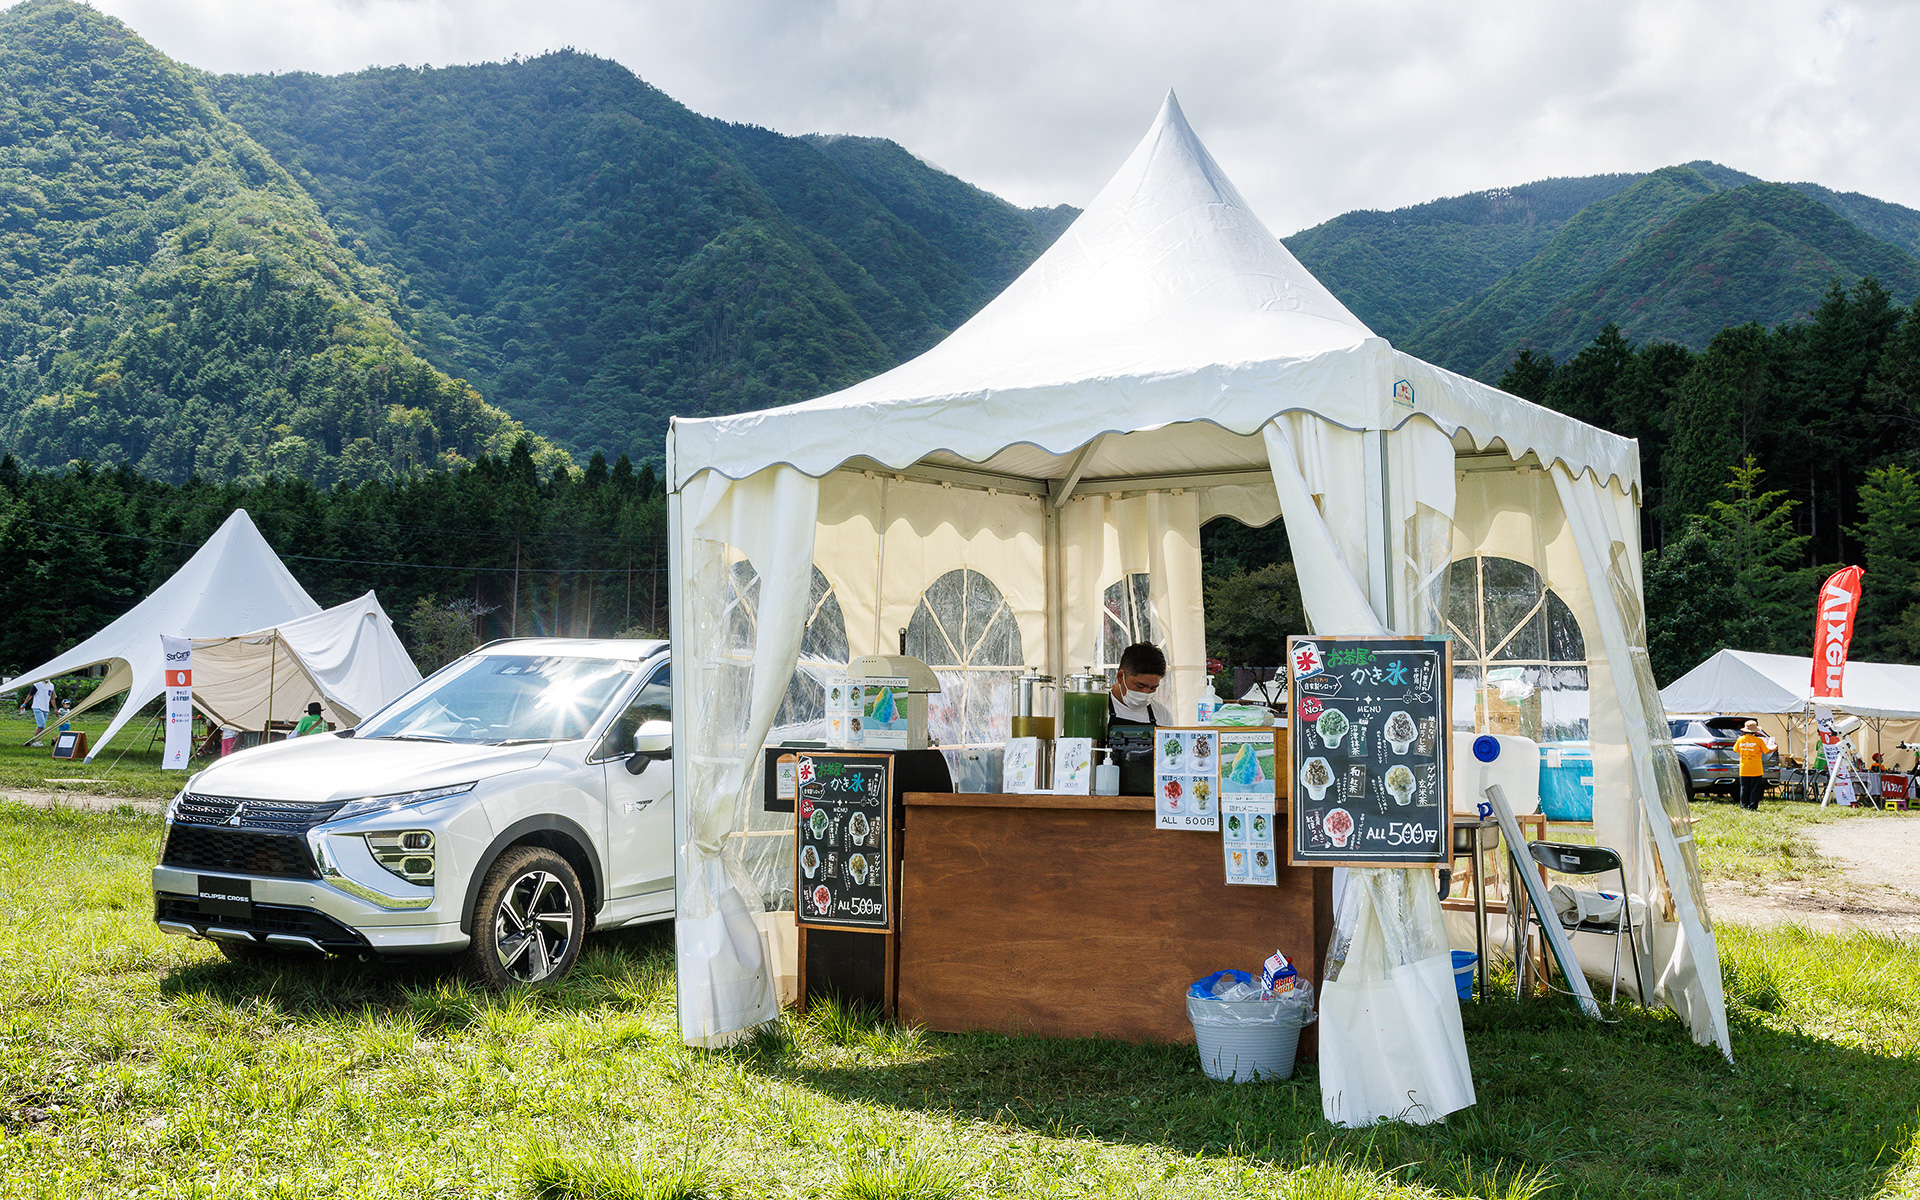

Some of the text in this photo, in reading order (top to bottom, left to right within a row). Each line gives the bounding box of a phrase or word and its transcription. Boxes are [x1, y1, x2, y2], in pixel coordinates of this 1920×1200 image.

[1823, 585, 1852, 692] Vixen
[166, 651, 190, 661] StarCamp
[1297, 652, 1318, 671] 氷
[1328, 648, 1376, 668] お茶屋の
[1350, 660, 1408, 686] かき氷
[1418, 723, 1427, 753] ほうじ茶
[800, 765, 812, 780] 氷
[817, 762, 846, 777] お茶屋の
[830, 772, 865, 792] かき氷
[1349, 767, 1360, 794] 和紅茶
[1427, 765, 1436, 795] ゲゲゲの
[1881, 780, 1903, 792] Vixen
[1418, 779, 1428, 805] 玄米茶
[1162, 816, 1214, 825] ALL 500円
[1306, 816, 1319, 842] 紅ほっぺ
[1366, 827, 1386, 840] ALL
[1387, 822, 1438, 845] 500円
[200, 892, 226, 900] ECLIPSE
[851, 897, 882, 915] 500円
